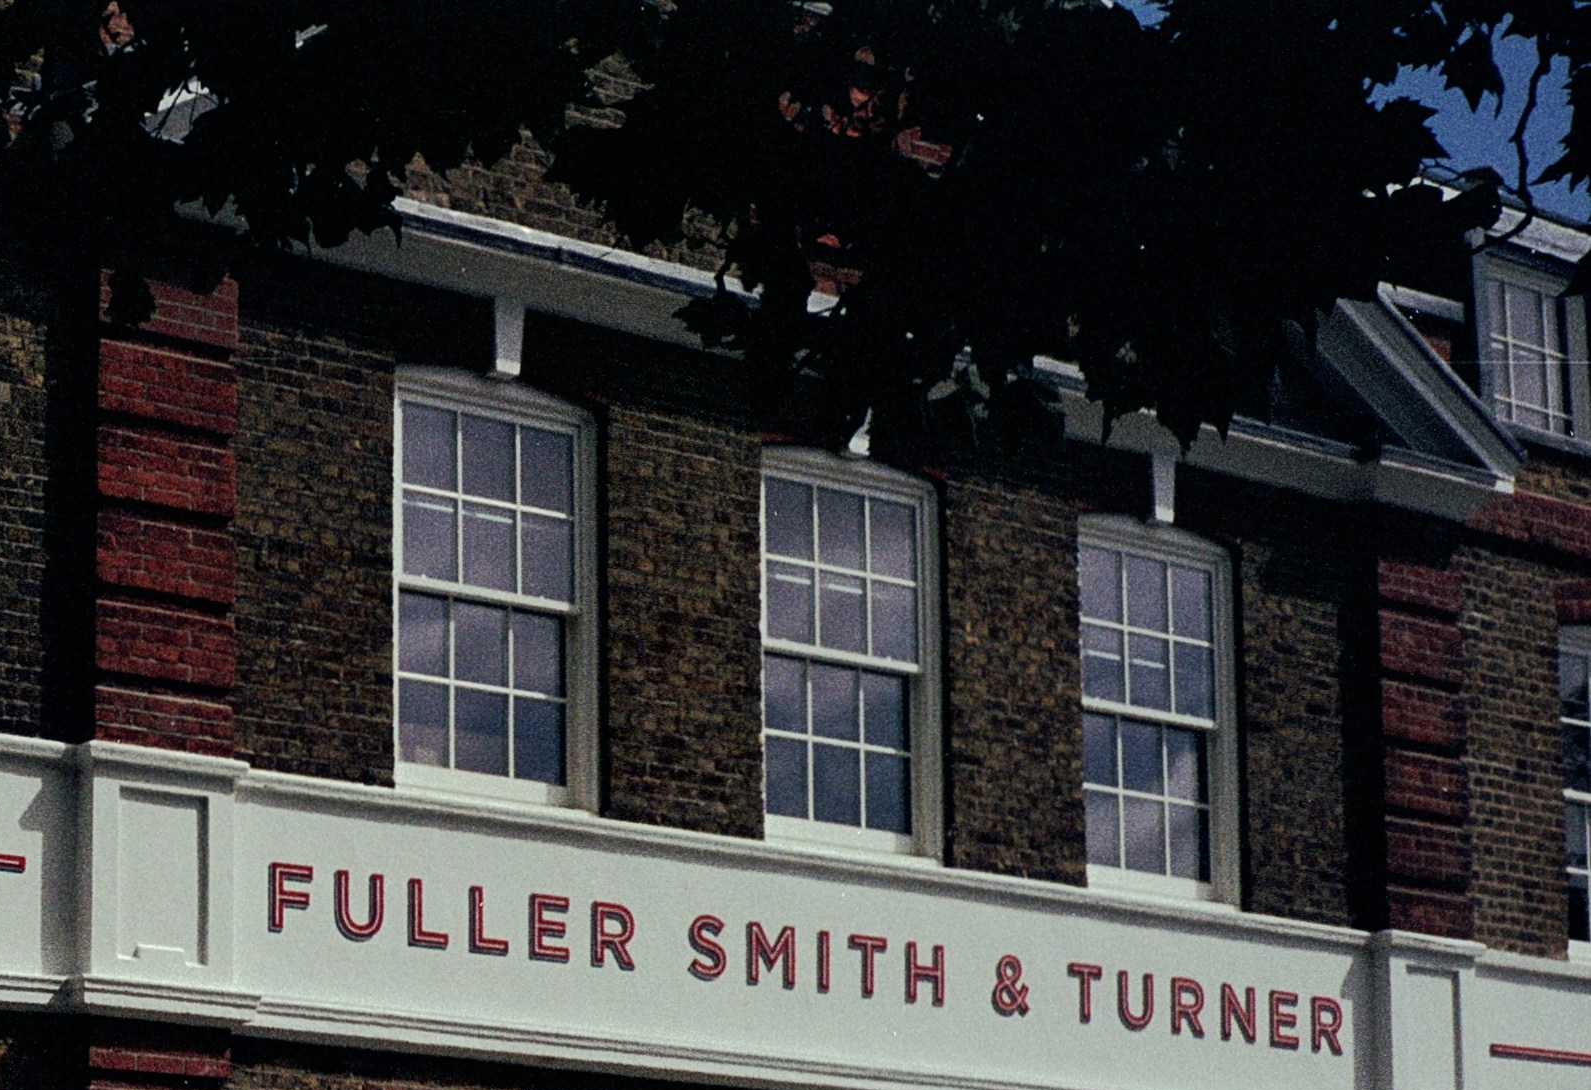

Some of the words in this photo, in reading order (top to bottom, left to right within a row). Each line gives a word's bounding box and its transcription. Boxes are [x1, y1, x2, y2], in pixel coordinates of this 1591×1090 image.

[268, 861, 636, 972] FULLER
[687, 914, 946, 1007] SMITH
[991, 954, 1031, 1018] &
[1067, 962, 1344, 1056] TURNER
